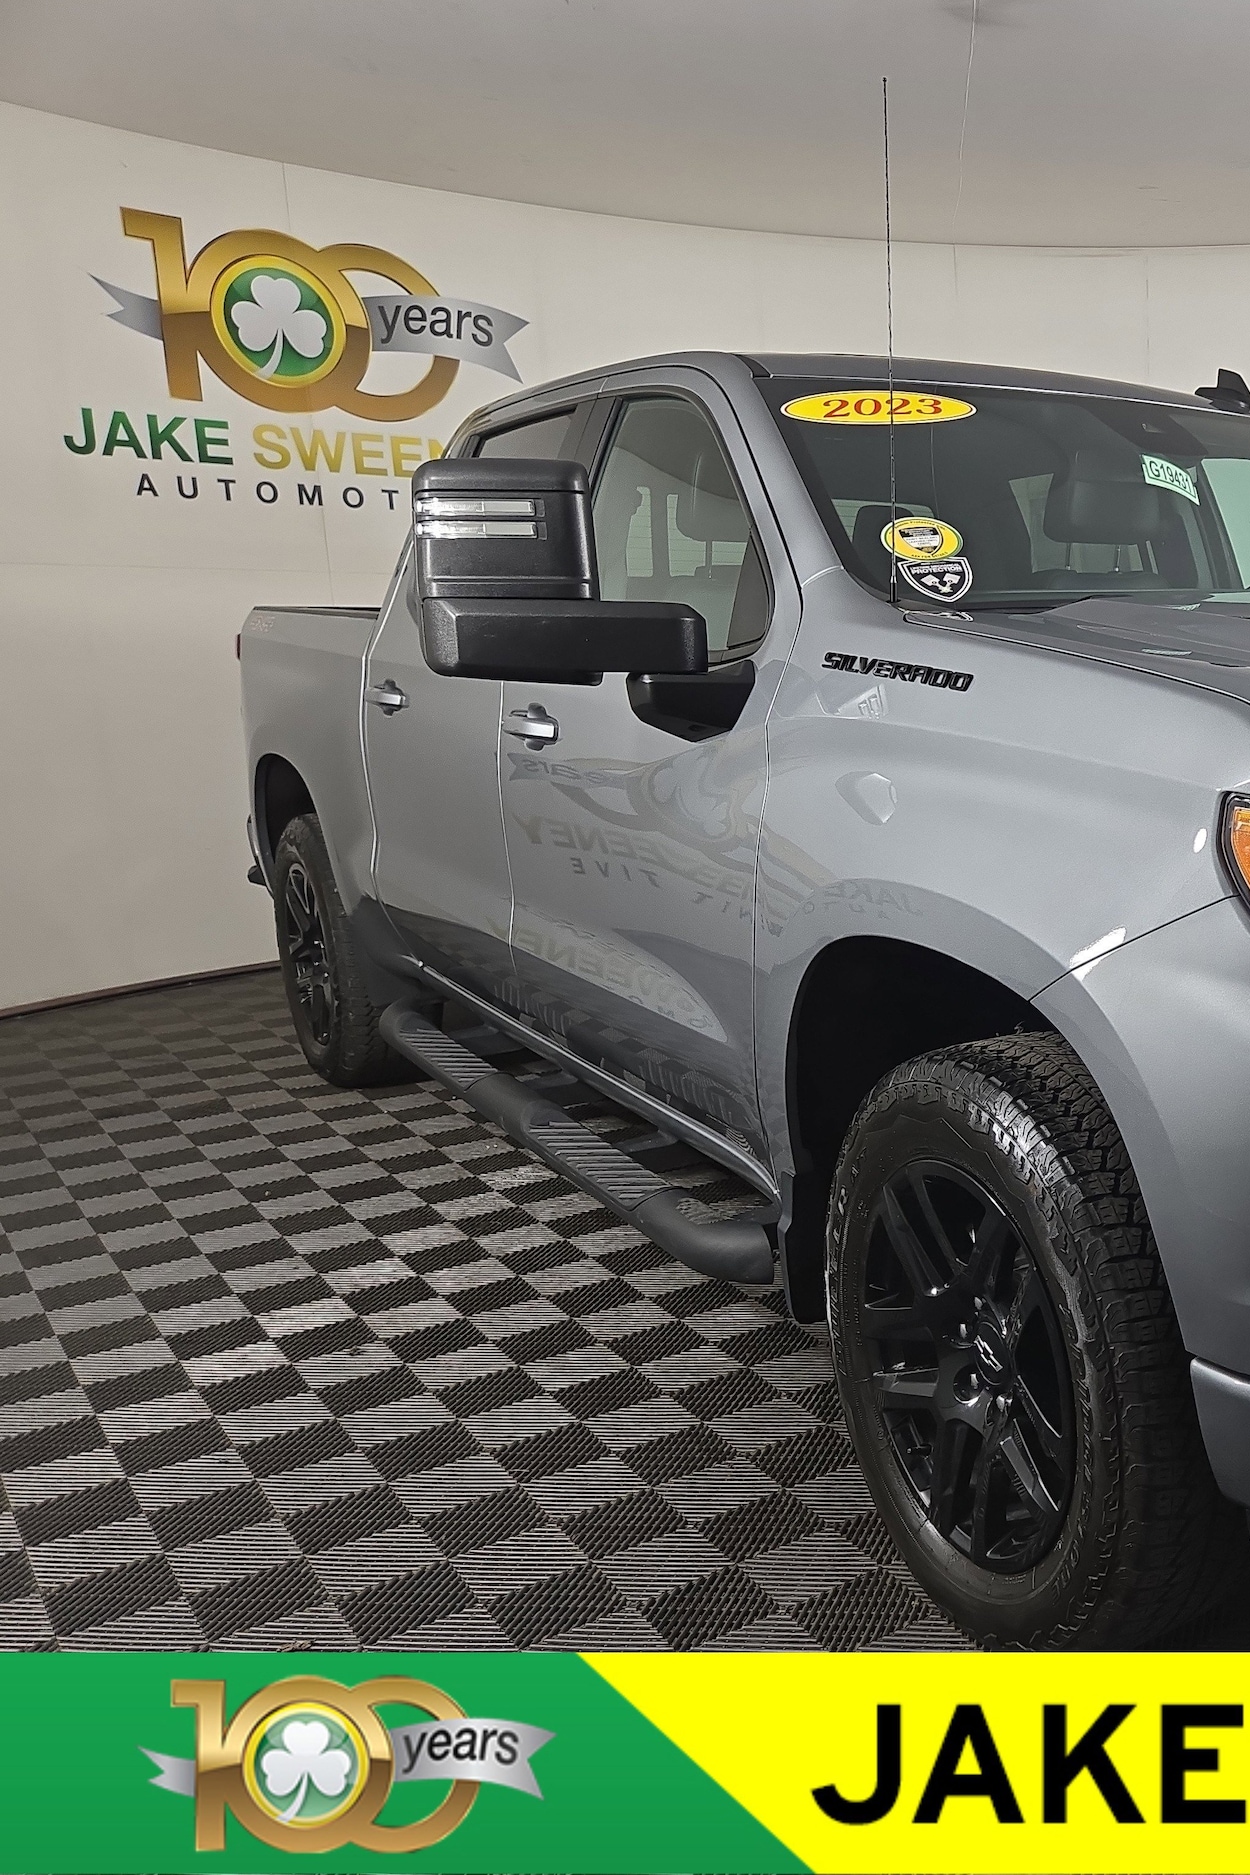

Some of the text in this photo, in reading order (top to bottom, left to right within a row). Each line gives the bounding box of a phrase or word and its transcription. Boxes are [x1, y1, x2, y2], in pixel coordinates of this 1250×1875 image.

[377, 299, 495, 347] years
[823, 397, 943, 418] 2023
[64, 407, 445, 477] JAKE SWEE
[136, 472, 400, 511] AUTOMOT
[1148, 460, 1192, 493] G19431
[821, 651, 974, 692] SILVERADO
